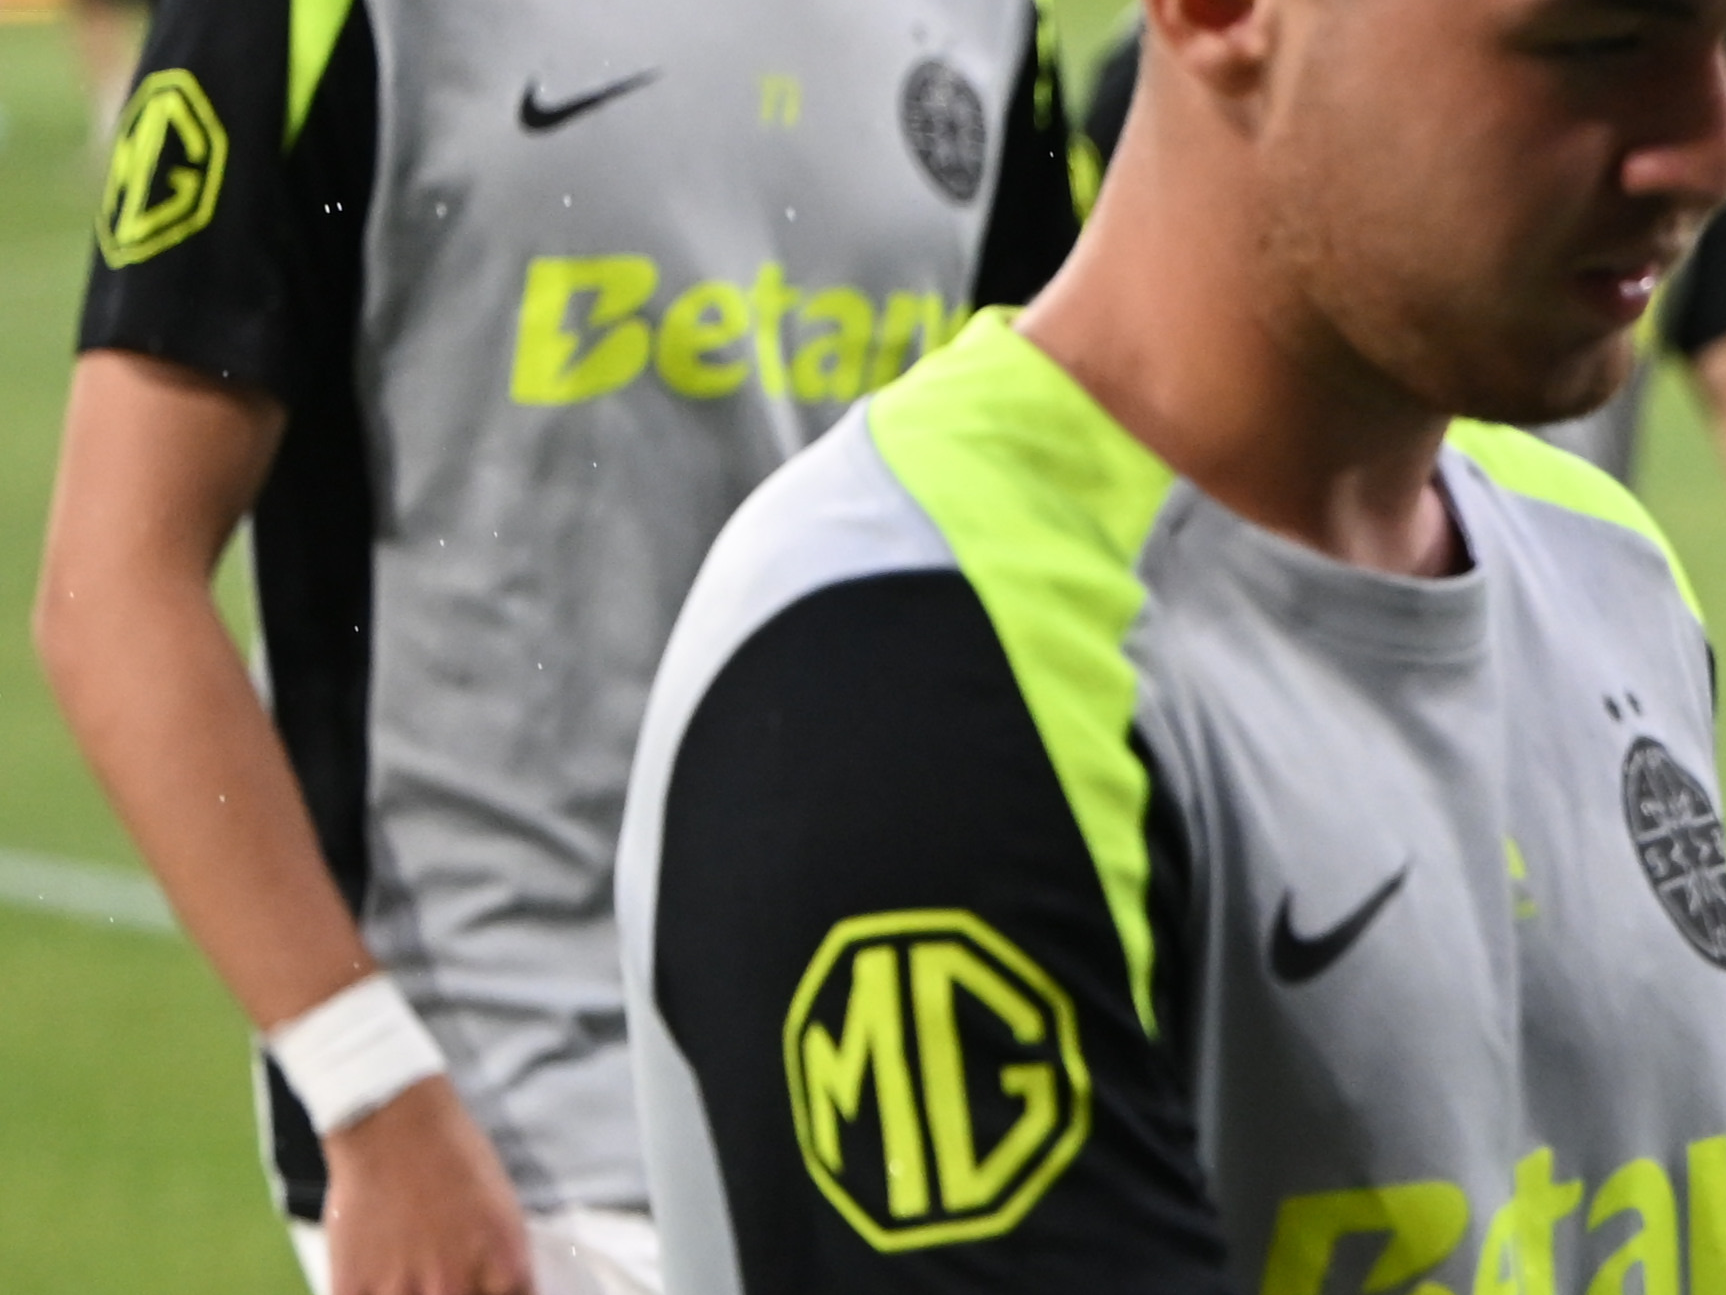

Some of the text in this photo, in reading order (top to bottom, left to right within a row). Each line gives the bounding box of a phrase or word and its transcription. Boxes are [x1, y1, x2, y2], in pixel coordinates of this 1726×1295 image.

[113, 88, 208, 244] MG
[509, 255, 975, 404] Betan
[802, 939, 1058, 1218] MG
